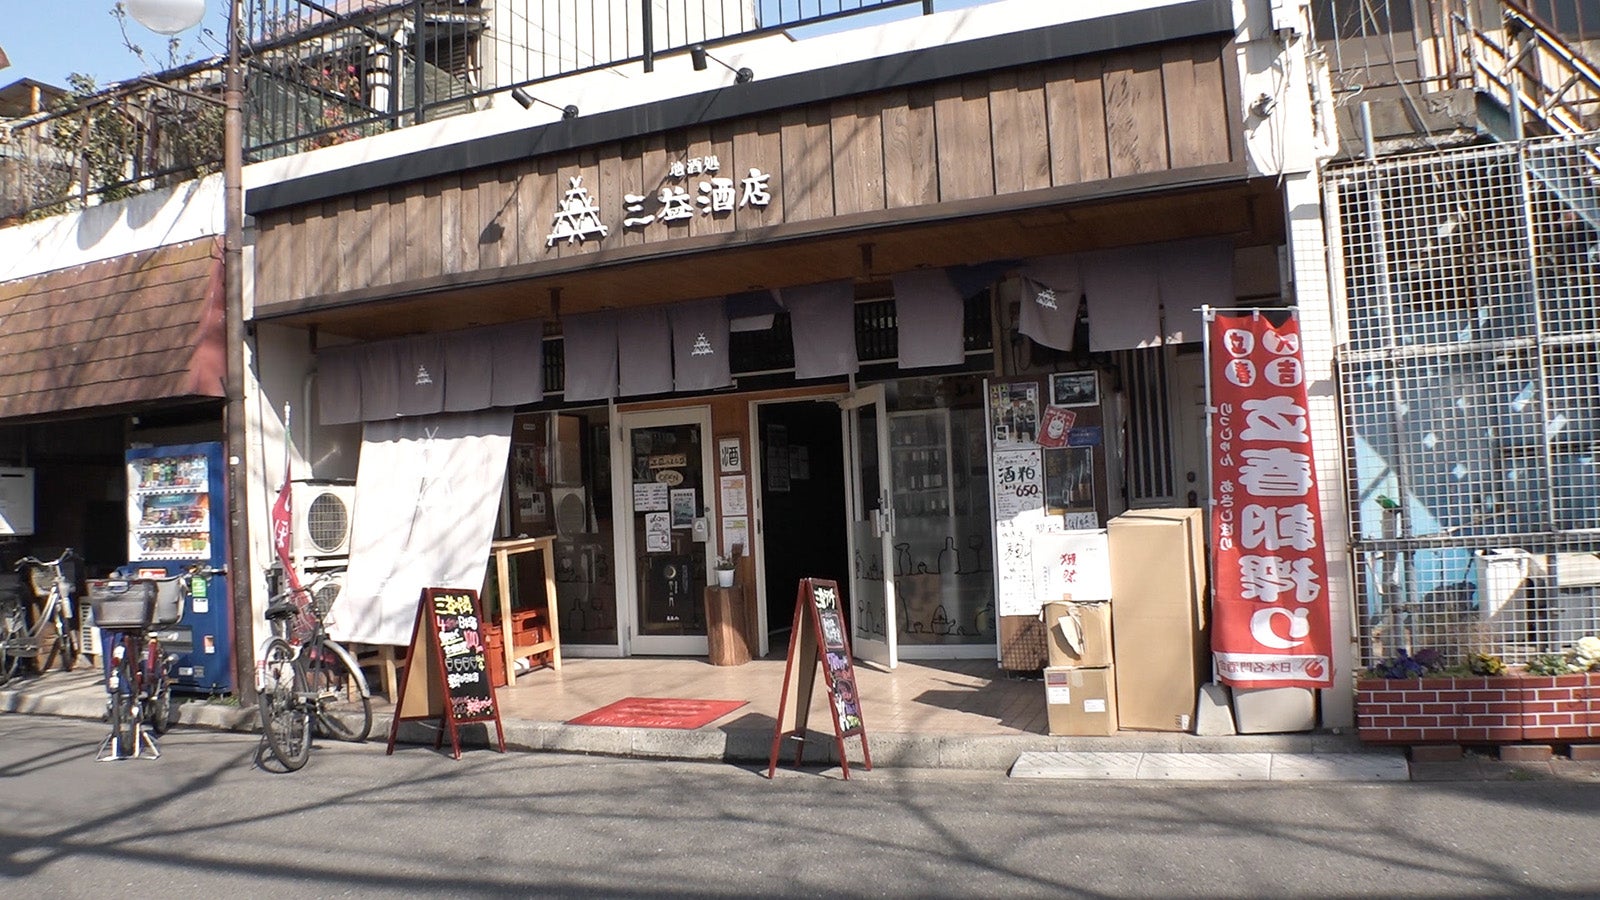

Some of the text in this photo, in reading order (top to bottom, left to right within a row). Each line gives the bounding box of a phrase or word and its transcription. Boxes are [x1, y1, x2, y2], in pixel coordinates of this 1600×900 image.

[669, 155, 720, 176] 地酒処
[624, 168, 771, 227] 三益酒店
[998, 465, 1036, 484] 酒粕
[1016, 484, 1038, 497] 650
